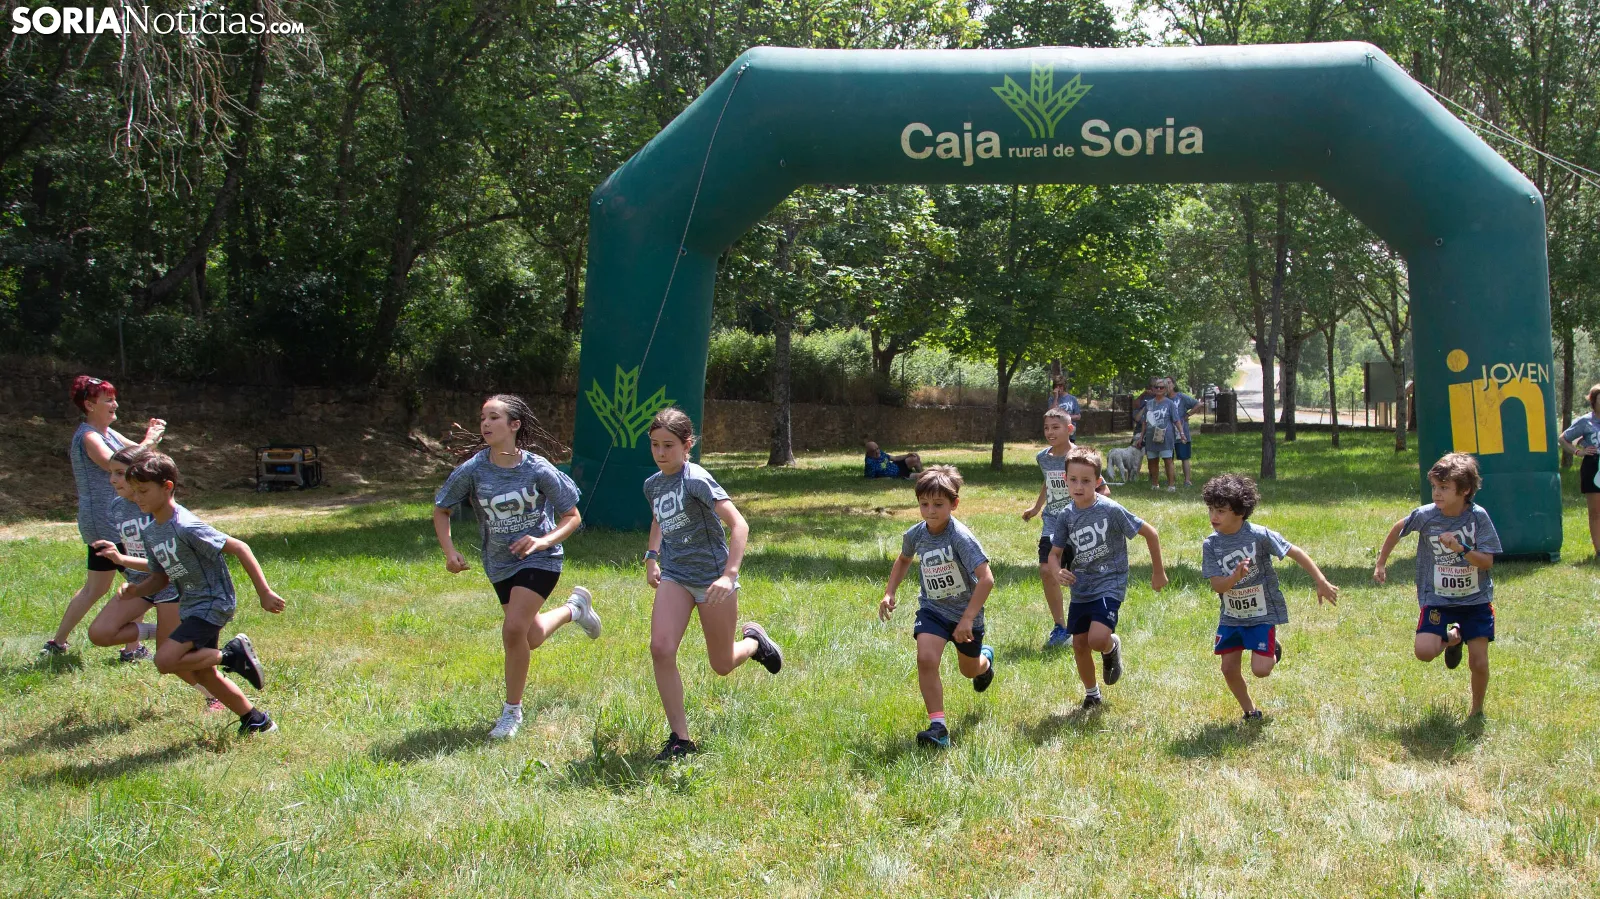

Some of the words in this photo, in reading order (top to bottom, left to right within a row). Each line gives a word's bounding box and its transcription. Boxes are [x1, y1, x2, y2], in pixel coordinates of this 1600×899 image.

[901, 121, 1001, 167] Caja
[1008, 143, 1048, 158] rural
[1053, 142, 1075, 157] de
[1080, 117, 1204, 158] Soria
[1482, 362, 1550, 391] JOVEN
[1446, 348, 1548, 455] in
[1051, 479, 1069, 489] 000
[926, 575, 955, 591] 0059
[1442, 576, 1472, 589] 0055
[1228, 597, 1258, 611] 0054
